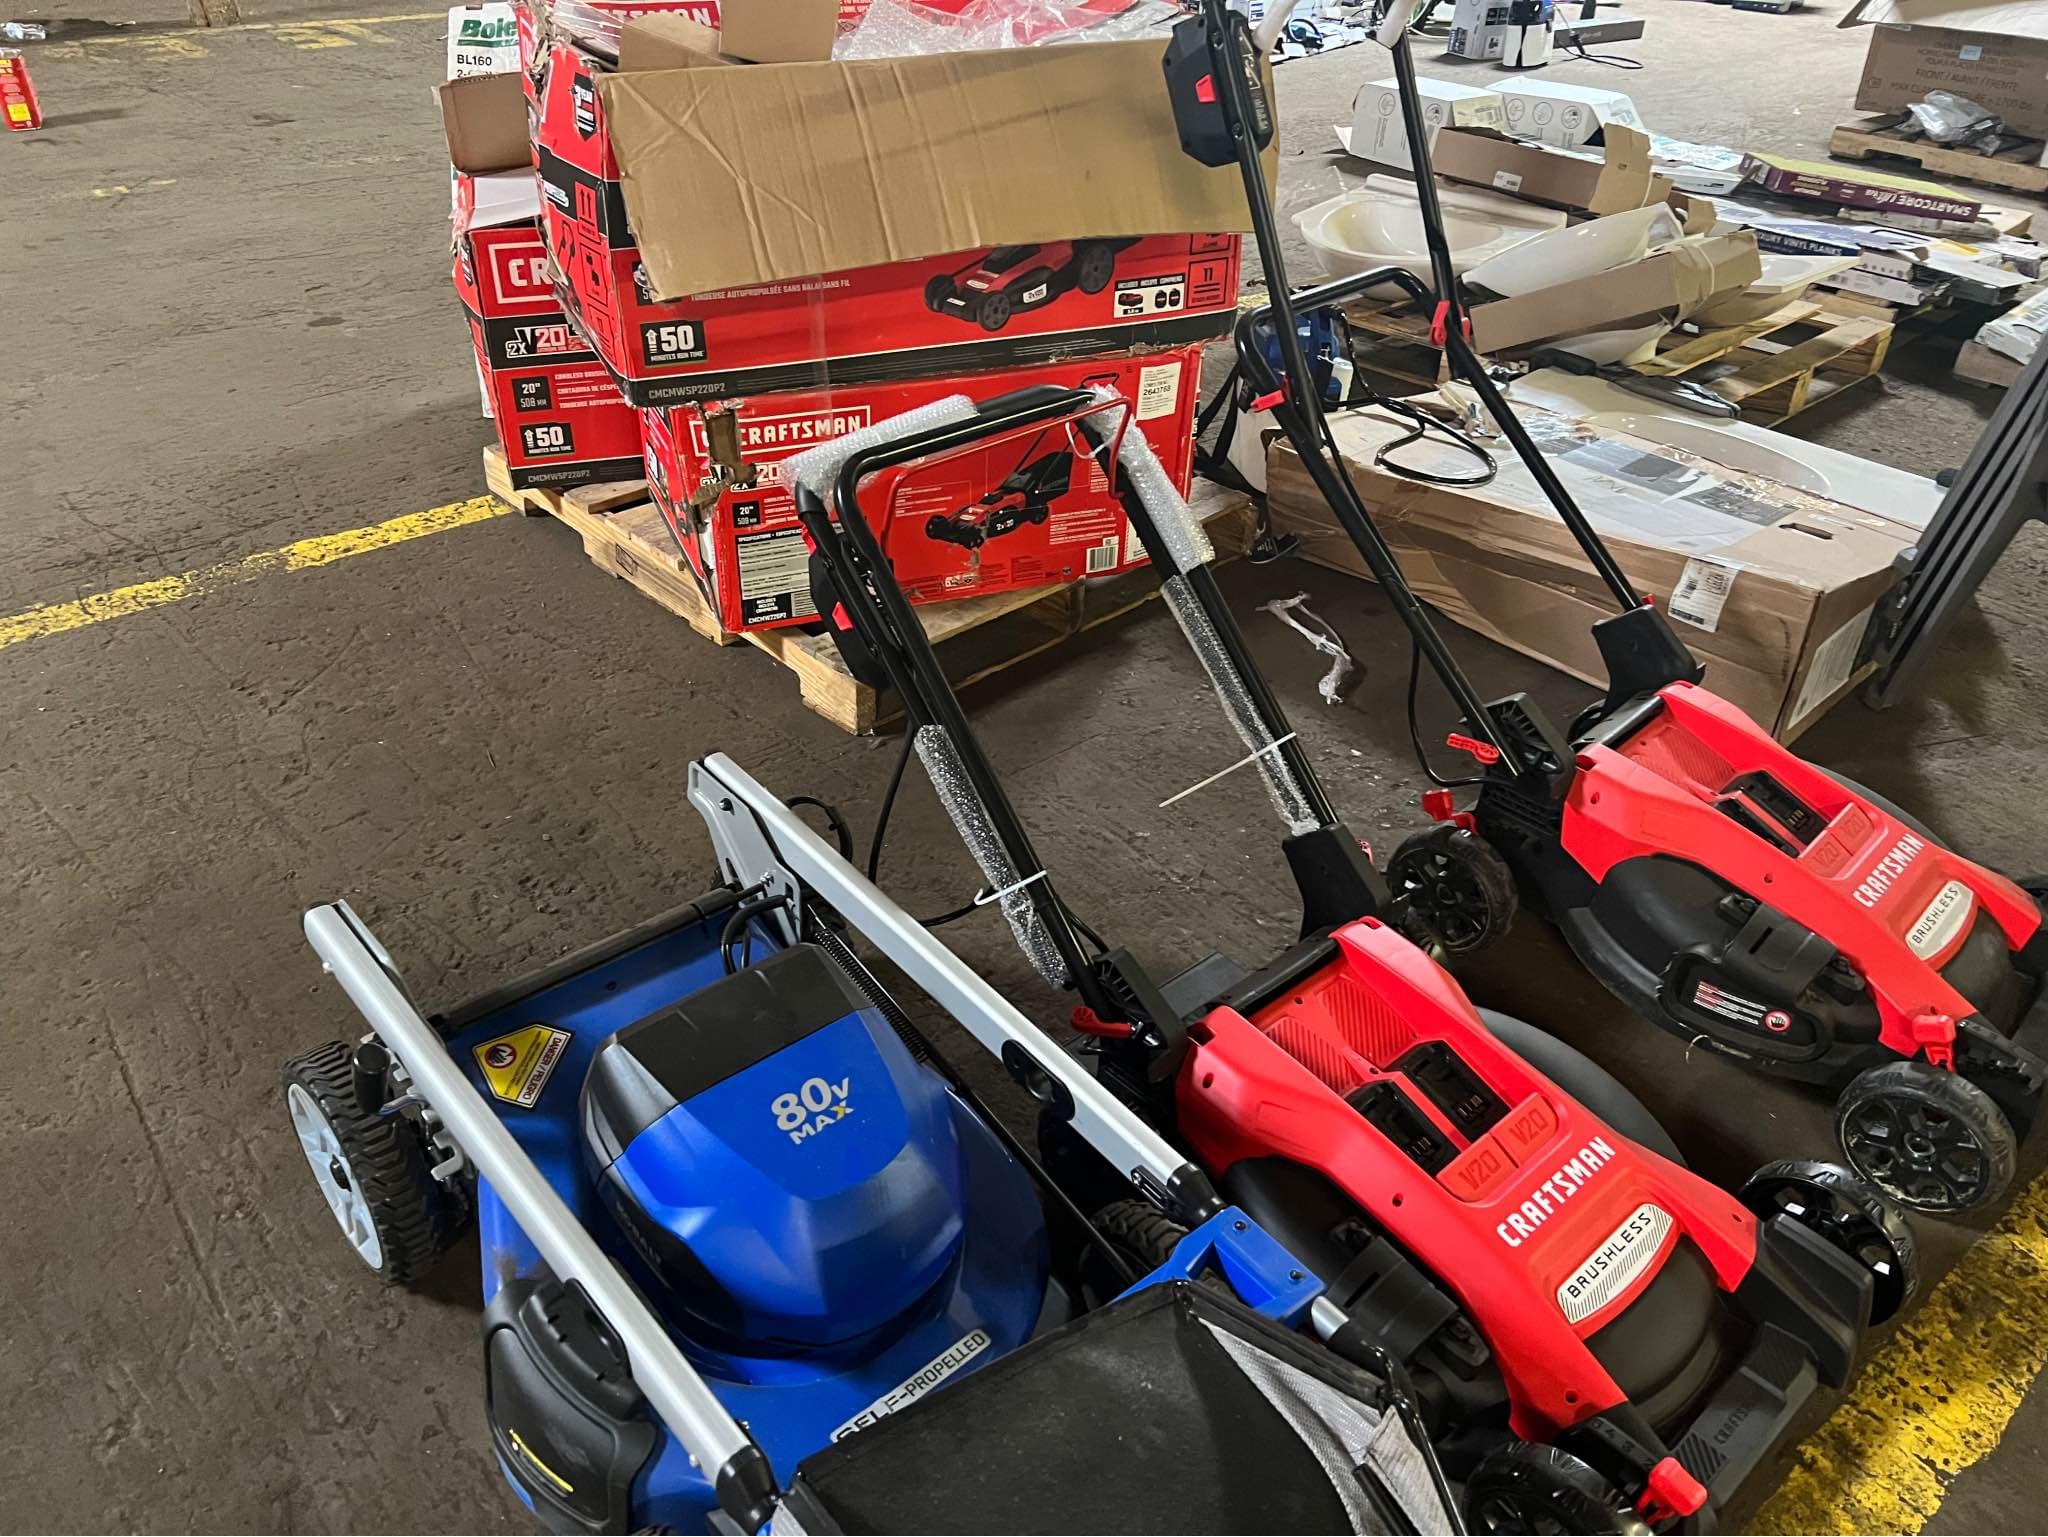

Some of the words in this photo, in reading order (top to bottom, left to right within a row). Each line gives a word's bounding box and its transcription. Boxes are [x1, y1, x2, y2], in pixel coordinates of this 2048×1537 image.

[456, 54, 492, 66] BL160
[1899, 194, 1973, 217] SMARTCORE
[660, 324, 695, 352] 50
[535, 425, 565, 448] 50
[1851, 832, 1925, 909] CRAFTSMAN
[1911, 886, 1959, 945] BRUSHLESS
[543, 1037, 562, 1067] DANGER
[789, 1099, 854, 1145] MAX
[1509, 1107, 1549, 1147] V20
[1458, 1149, 1500, 1191] V20
[1496, 1136, 1617, 1248] CRAFTSMAN
[1567, 1211, 1652, 1298] BRUSHLESS
